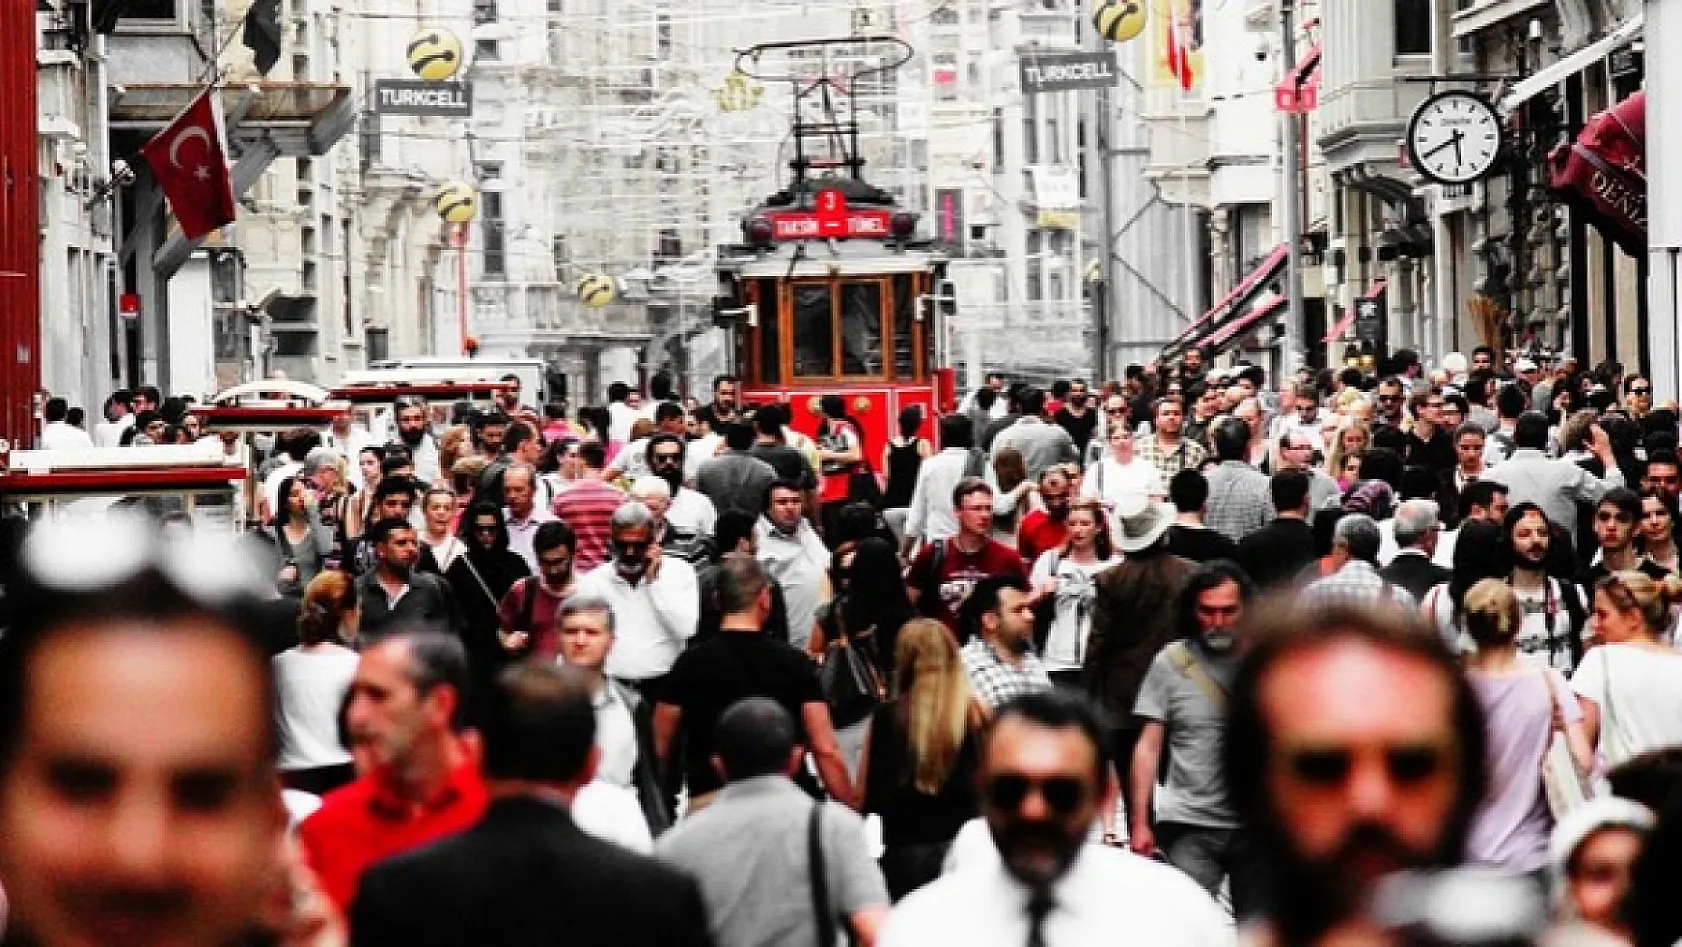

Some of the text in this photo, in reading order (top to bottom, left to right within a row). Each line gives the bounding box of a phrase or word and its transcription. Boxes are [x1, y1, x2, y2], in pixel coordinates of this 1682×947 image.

[1025, 61, 1113, 83] TURKCELL
[380, 89, 468, 108] TURKCELL
[824, 191, 837, 211] 3
